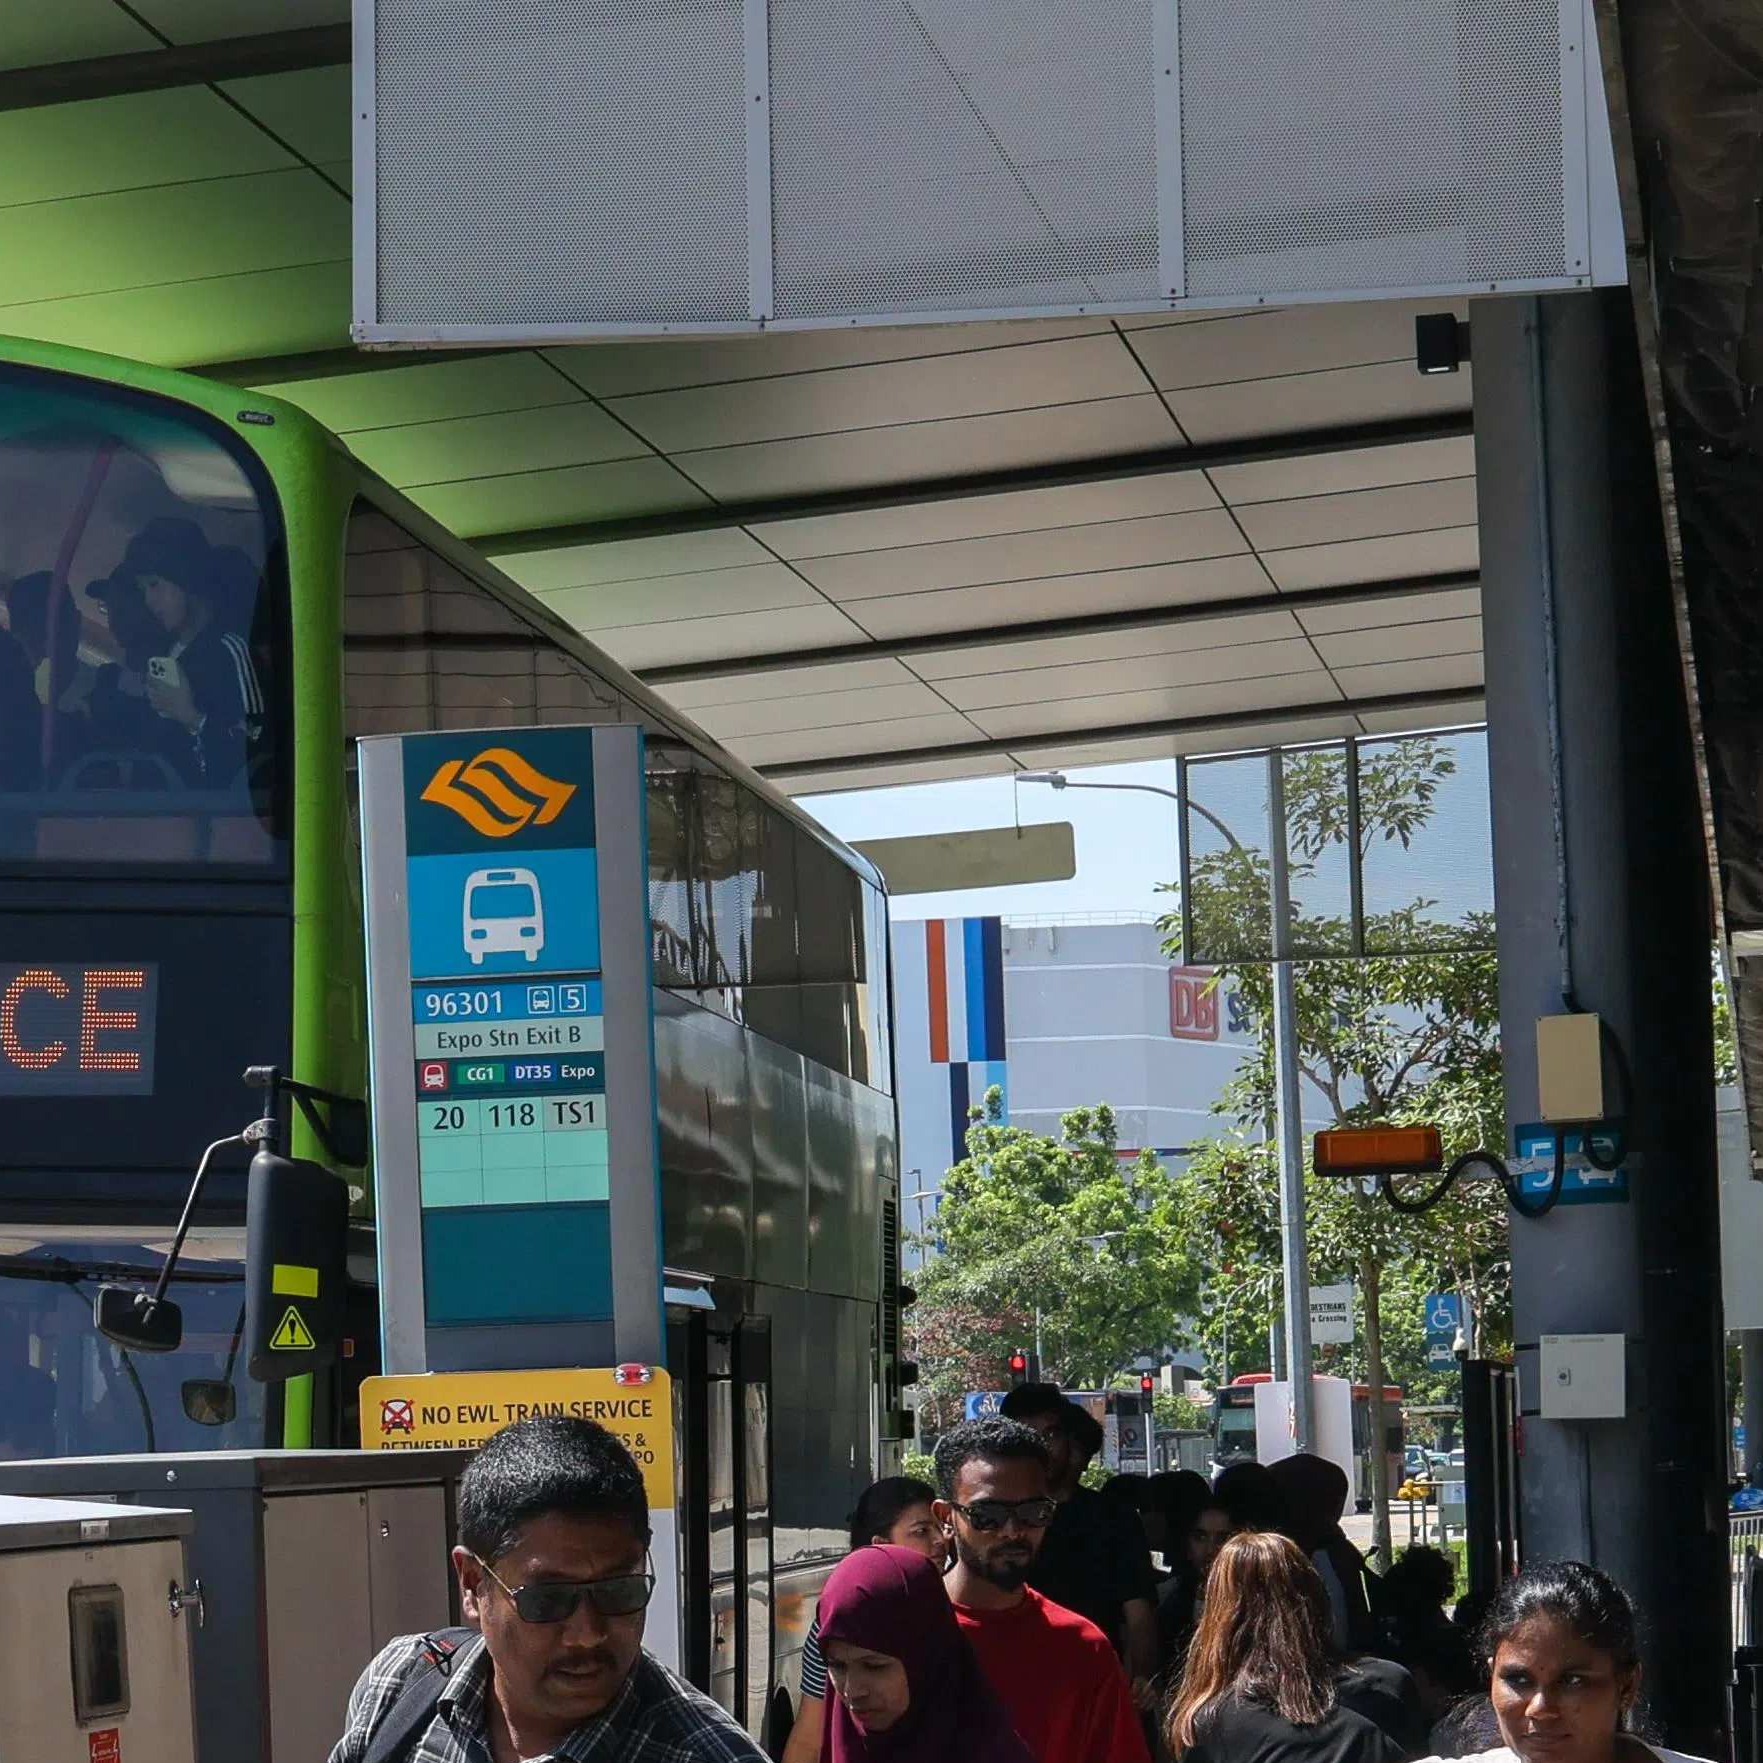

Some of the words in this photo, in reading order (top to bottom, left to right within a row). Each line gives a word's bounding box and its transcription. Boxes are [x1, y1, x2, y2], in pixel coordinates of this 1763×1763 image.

[426, 991, 502, 1016] 96301
[567, 989, 580, 1009] 5
[1176, 981, 1214, 1028] DB
[438, 1032, 482, 1051] Expo
[490, 1029, 519, 1046] Stn
[527, 1026, 561, 1044] Exit
[569, 1026, 581, 1043] B
[467, 1068, 493, 1081] CG1
[515, 1065, 551, 1078] DT35
[562, 1066, 595, 1081] Expo
[434, 1107, 464, 1130] 20
[489, 1103, 534, 1127] 118
[553, 1101, 594, 1124] TS1
[1532, 1142, 1555, 1187] 5
[422, 1406, 450, 1424] NO
[457, 1404, 500, 1423] EWL
[504, 1402, 564, 1422] TRAIN
[570, 1399, 652, 1419] SERVICE
